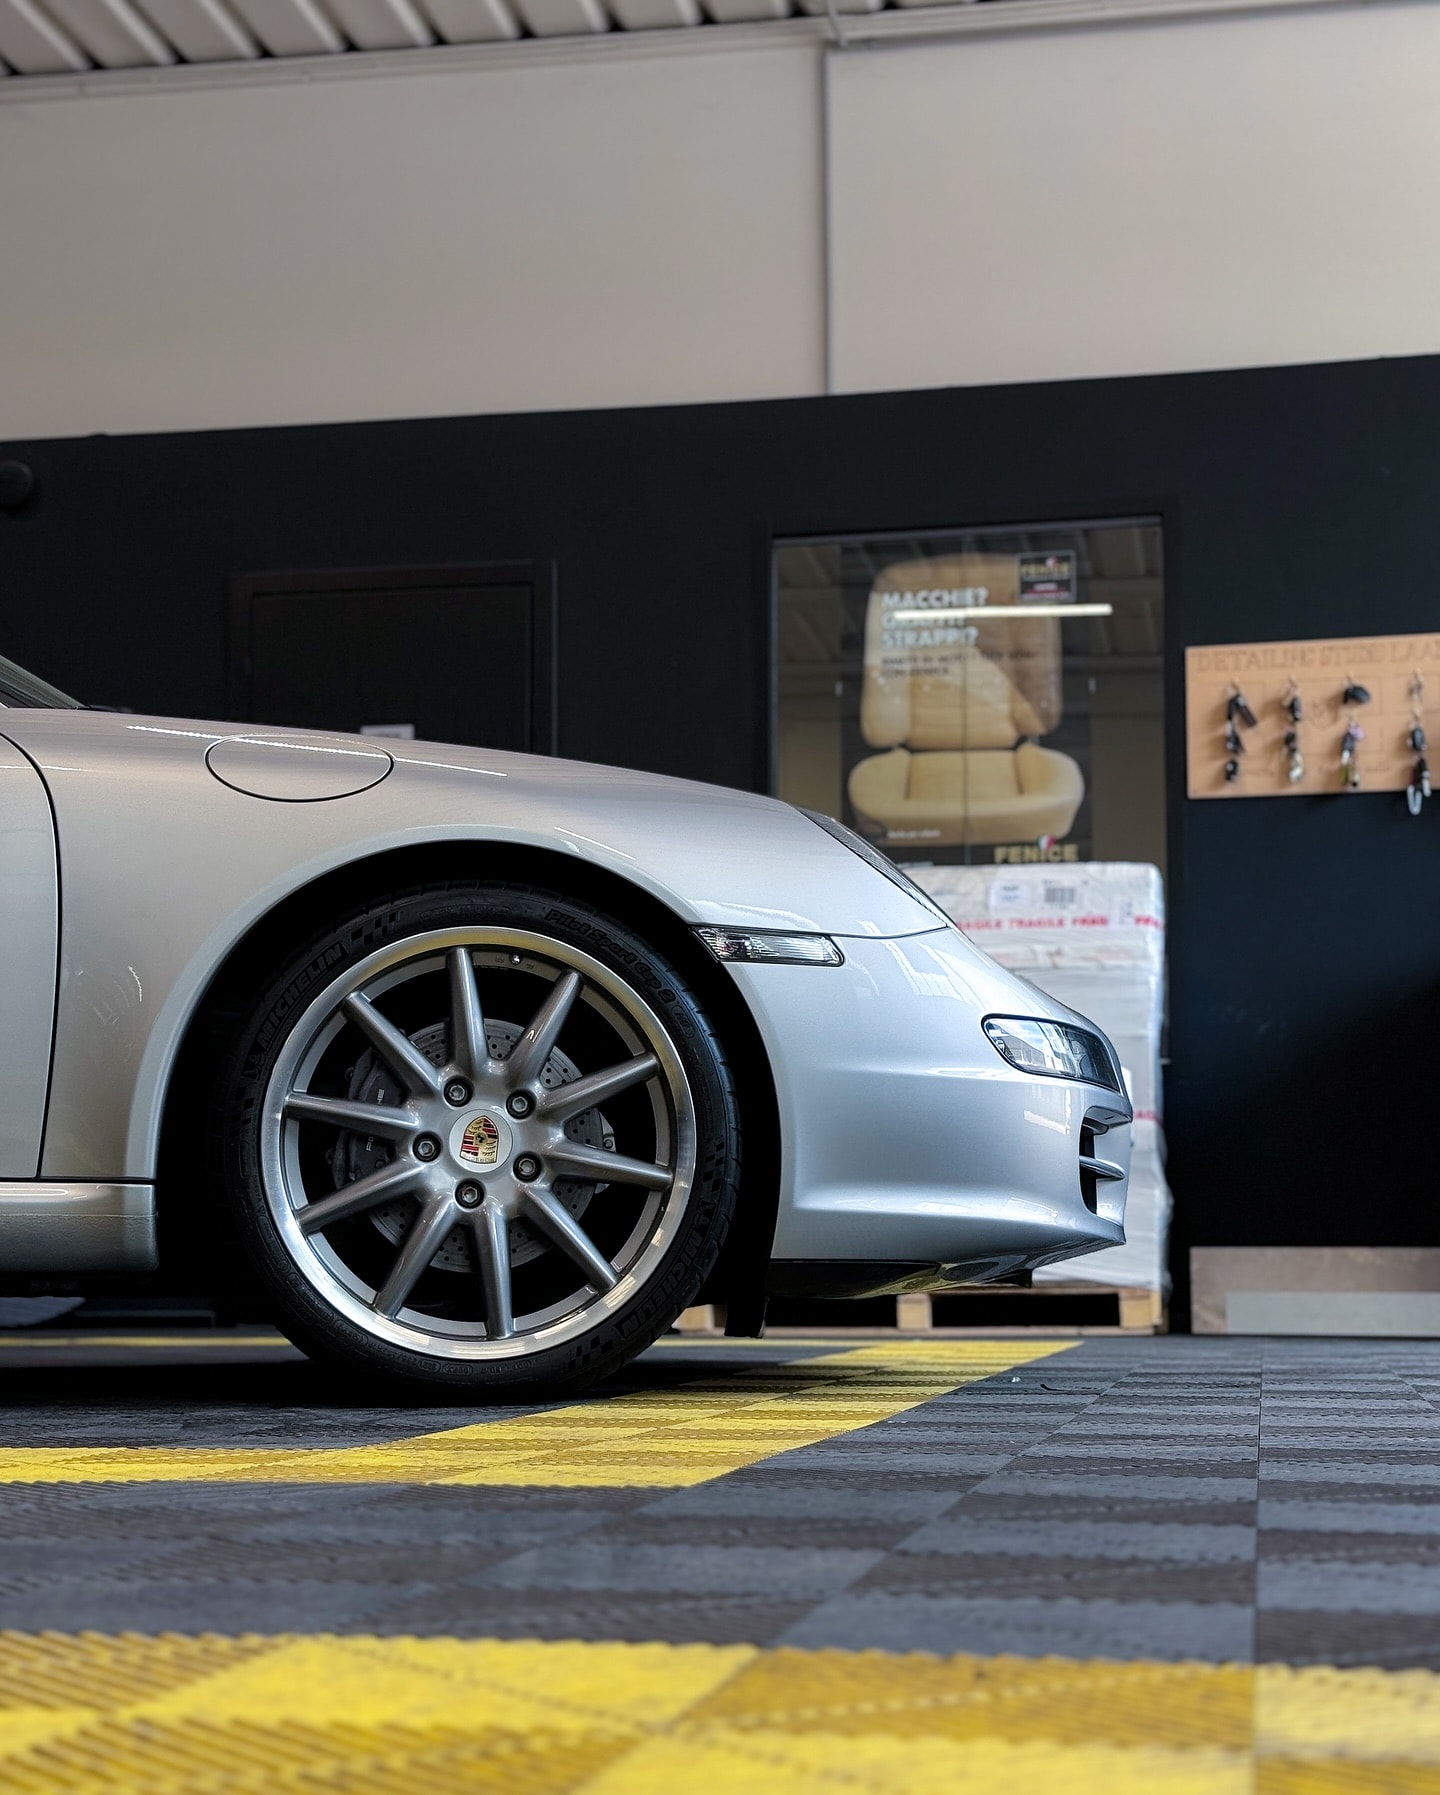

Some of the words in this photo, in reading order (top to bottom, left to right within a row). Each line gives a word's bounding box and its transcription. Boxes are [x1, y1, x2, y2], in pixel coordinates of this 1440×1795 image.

[881, 587, 989, 610] MACCHIE?
[993, 843, 1079, 864] FENICE
[544, 908, 592, 936] Pilot
[585, 928, 641, 965] Sport
[634, 961, 663, 990] Cup
[1008, 916, 1066, 931] FRAGILE
[256, 943, 343, 1049] MICHELIN
[621, 1230, 703, 1338] MICHELIN
